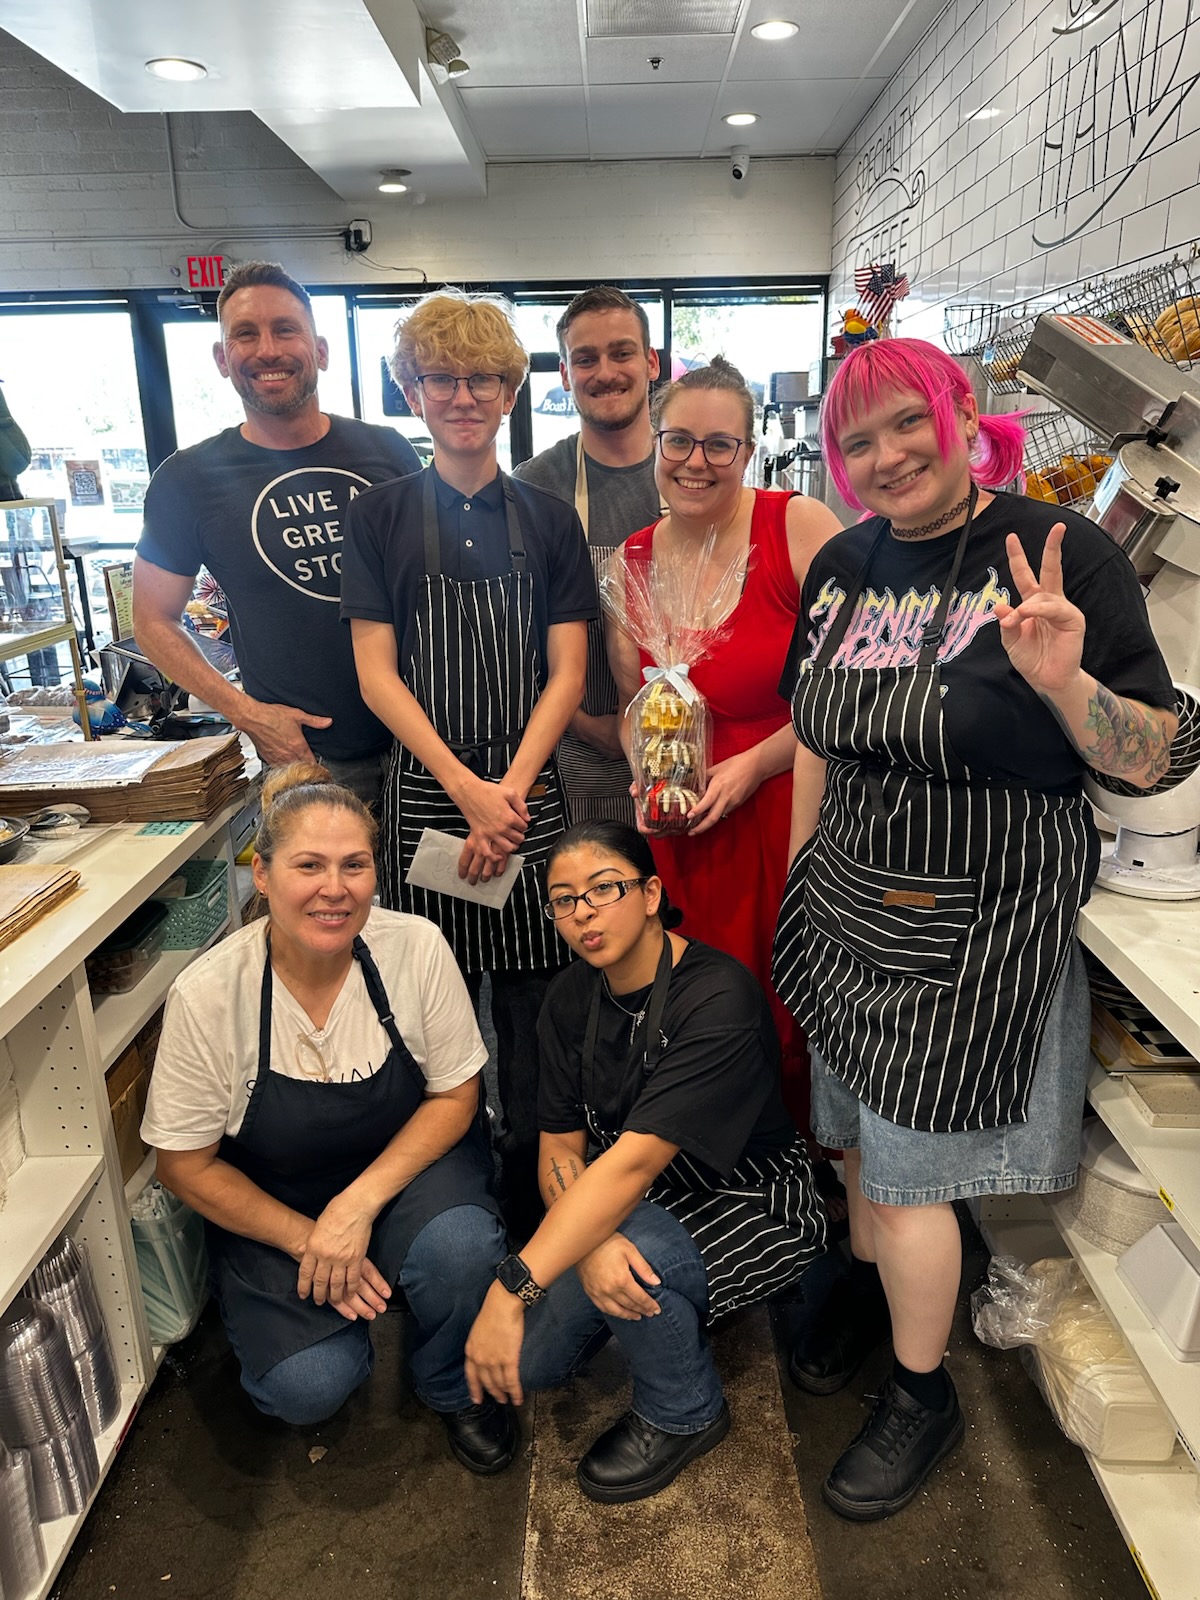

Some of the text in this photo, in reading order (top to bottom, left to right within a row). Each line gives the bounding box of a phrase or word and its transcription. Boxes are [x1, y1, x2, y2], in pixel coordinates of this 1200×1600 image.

[855, 96, 918, 215] SPECIALTY
[186, 255, 223, 288] EXIT
[268, 489, 339, 519] LIVE
[282, 520, 344, 549] GRE
[294, 552, 342, 581] STO
